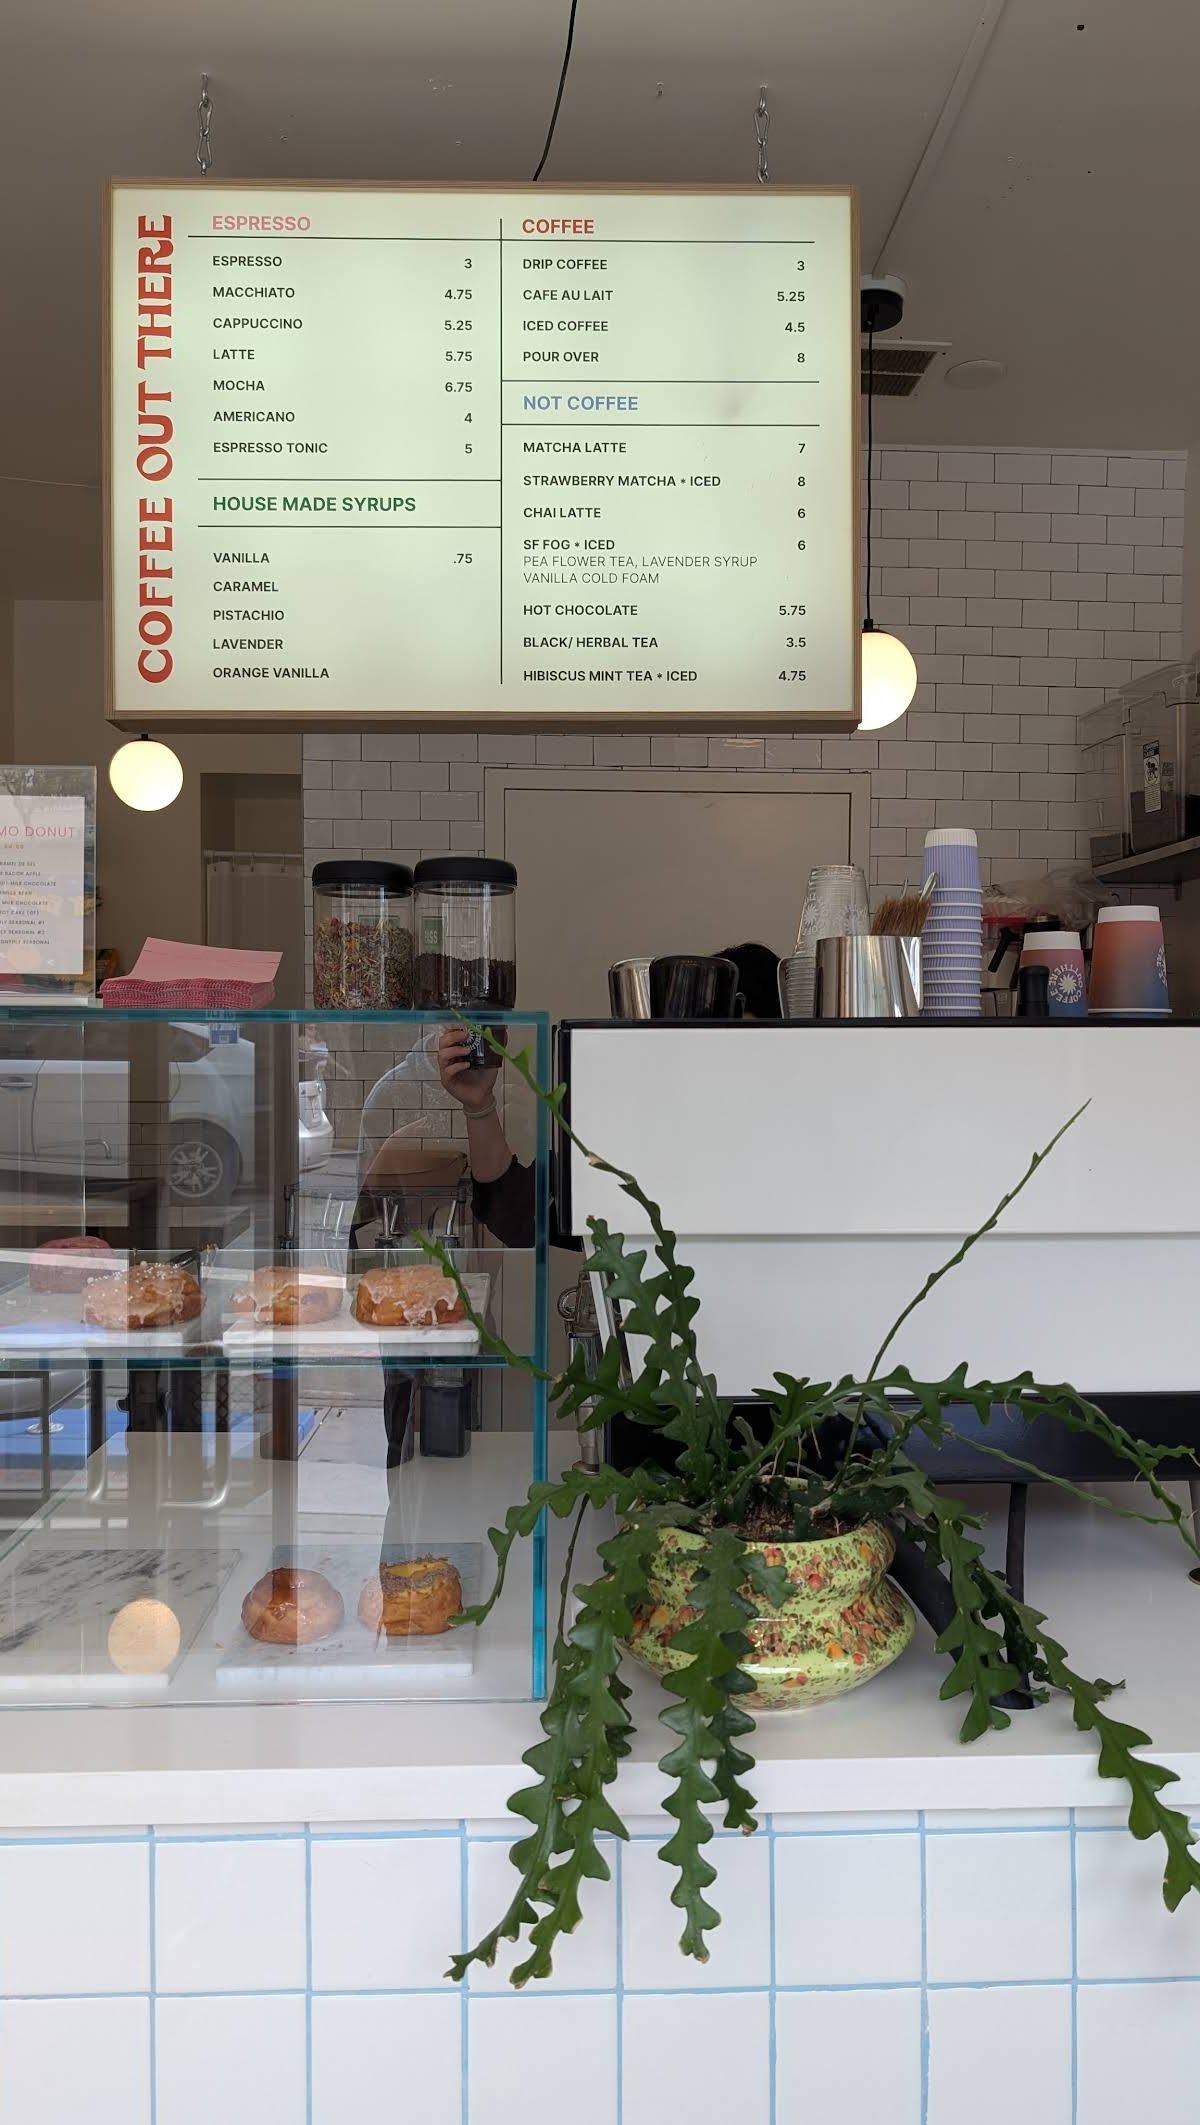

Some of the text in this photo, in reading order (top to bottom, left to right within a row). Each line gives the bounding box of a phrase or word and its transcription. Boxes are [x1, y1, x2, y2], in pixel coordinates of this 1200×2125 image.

[212, 215, 311, 231] ESPRESSO
[522, 219, 595, 235] COFFEE
[212, 255, 473, 269] ESPRESSO 3
[522, 258, 805, 272] DRIP COFFEE 3
[212, 286, 473, 300] MACCHIATO 4.75
[522, 289, 806, 302] CAFE AU LAIT 5.25
[212, 317, 473, 331] CAPPUCCINO 5.25
[522, 320, 806, 333] ICED COFFEE 4.5
[213, 348, 473, 362] LATTE 5.75
[523, 351, 806, 364] POUR OVER 8
[213, 379, 473, 393] MOCHA 6.75
[523, 395, 639, 411] NOT COFFEE
[212, 410, 473, 424] AMERICANO 4
[137, 215, 173, 683] COFFEE OUT THERE
[213, 441, 473, 455] ESPRESSO TONIC 5
[523, 441, 806, 454] MATCHA LATTE 7
[523, 475, 806, 487] STRAWBERRY MATCHA ICED 8
[213, 496, 416, 512] HOUSE MADE SYRUPS
[523, 507, 806, 519] CHAI LATTE 6
[523, 539, 806, 551] SF FOG ICED 6
[212, 552, 473, 564] VANILLA .75
[523, 555, 758, 569] PEA FLOWER TEA, LAVENDER SYRUP
[523, 572, 660, 584] VANILLA COLD FOAM
[212, 581, 279, 593] CARAMEL
[213, 609, 285, 621] PISTACHIO
[523, 604, 807, 616] HOT CHOCOLATE 5.75
[212, 638, 284, 650] LAVENDER
[523, 636, 807, 650] BLACK/ HERBAL TEA 3.5
[212, 667, 330, 679] ORANGE VANILLA
[523, 670, 807, 682] HIBISCUS MINT TEA ICED 4.75
[25, 826, 75, 838] DONUT
